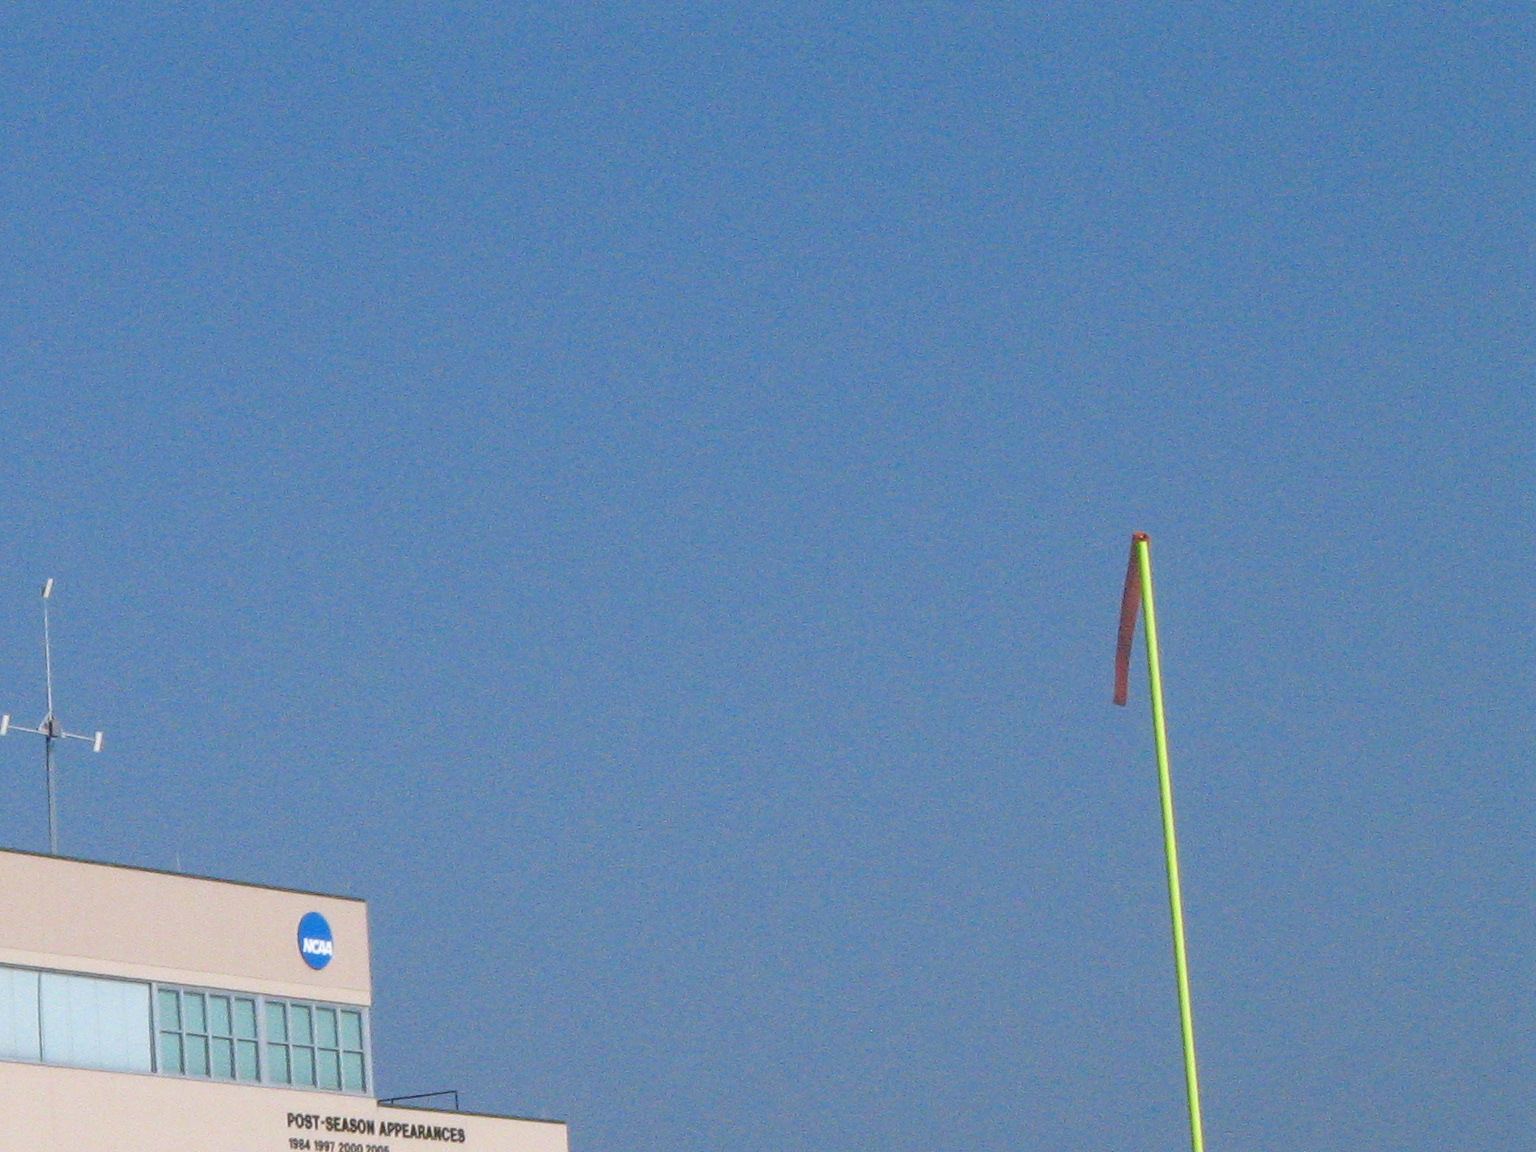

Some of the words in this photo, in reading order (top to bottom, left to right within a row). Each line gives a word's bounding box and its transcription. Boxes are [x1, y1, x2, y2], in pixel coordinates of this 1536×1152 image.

[302, 937, 333, 957] NCAA
[287, 1112, 375, 1136] POST-SEASON
[378, 1121, 466, 1144] APPEARANCES
[288, 1137, 311, 1151] 1984
[313, 1139, 335, 1152] 1997
